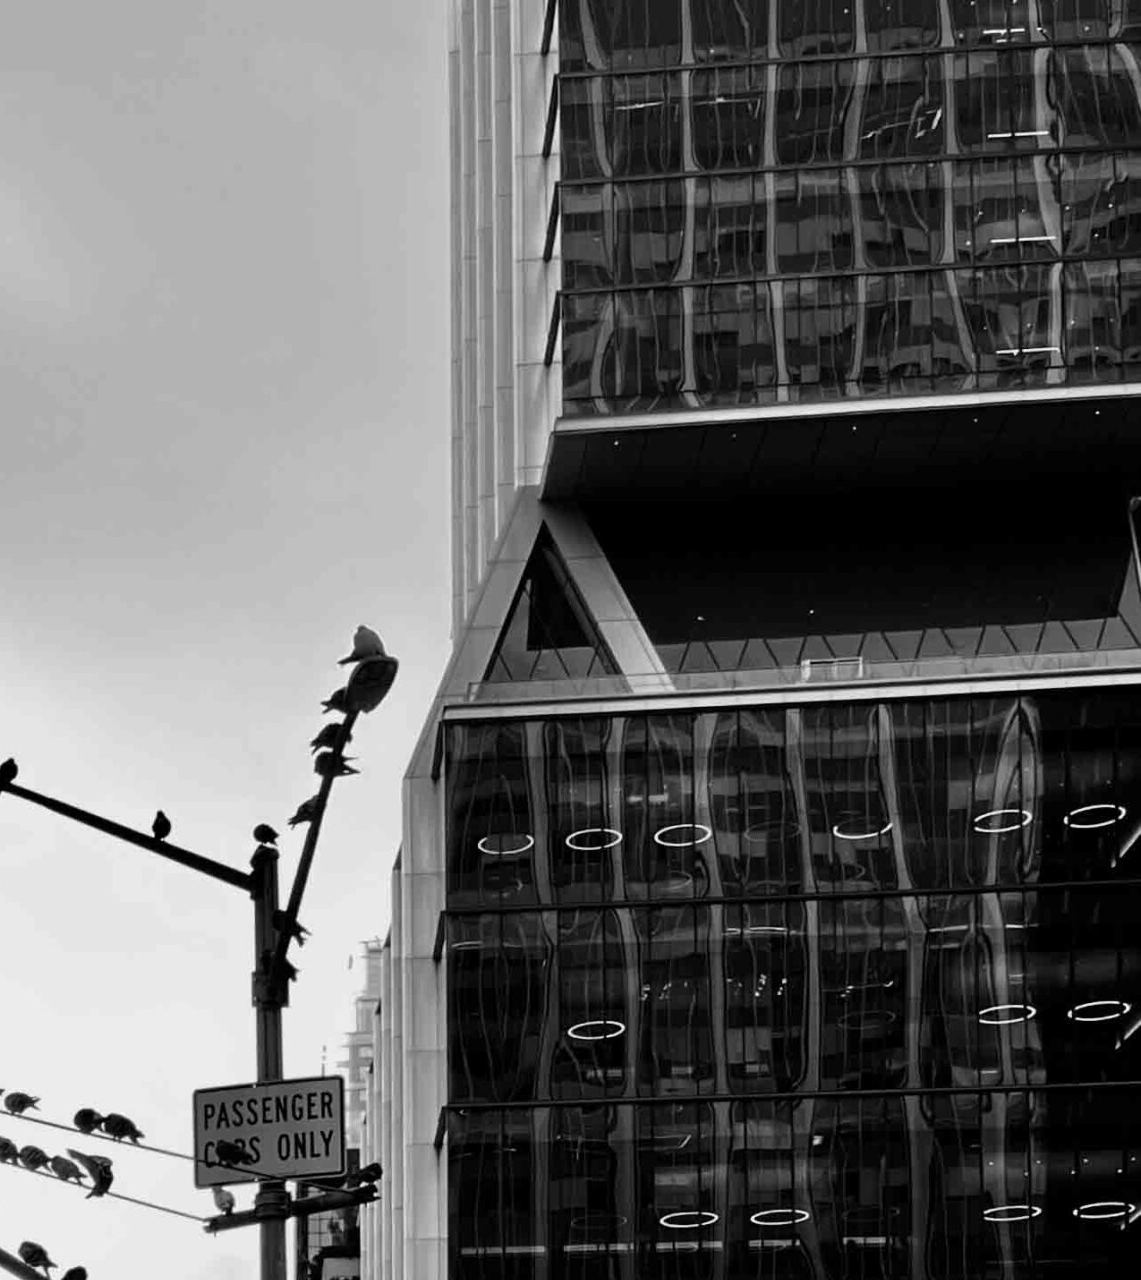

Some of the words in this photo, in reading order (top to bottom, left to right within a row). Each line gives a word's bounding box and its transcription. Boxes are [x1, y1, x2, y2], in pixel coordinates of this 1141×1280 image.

[203, 1091, 334, 1131] PASSENGER
[204, 1135, 261, 1168] CS
[277, 1129, 335, 1161] ONLY
